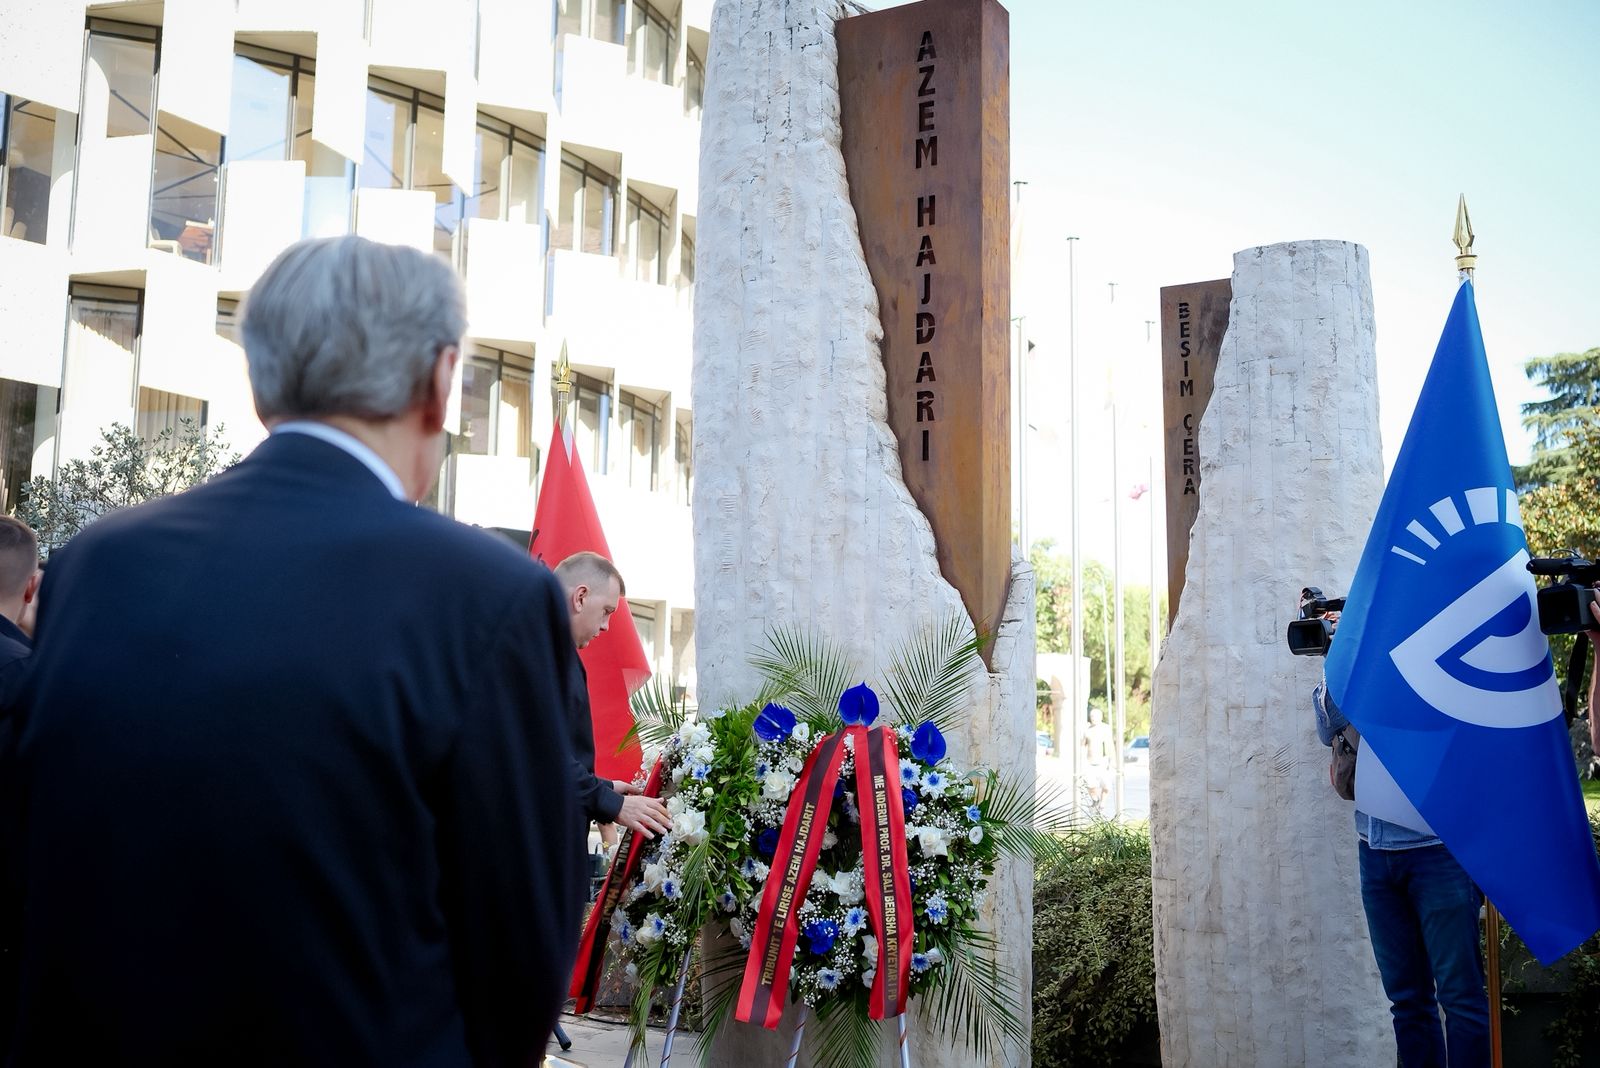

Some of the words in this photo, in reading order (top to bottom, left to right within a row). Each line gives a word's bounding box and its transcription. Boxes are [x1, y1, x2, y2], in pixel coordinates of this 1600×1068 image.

[915, 30, 938, 170] AZEM
[915, 194, 937, 462] HAJDARI
[1178, 302, 1194, 397] BESIM
[1183, 413, 1196, 495] ÇERA
[873, 774, 885, 789] ME
[876, 789, 889, 826] NDERIM
[794, 802, 816, 855] HAJDARIT
[879, 826, 890, 852] PROF.
[786, 855, 803, 884] AZEM
[881, 853, 891, 871] DR.
[776, 884, 794, 919] LIRISE
[882, 872, 893, 894] SALI
[883, 895, 896, 936] BERISHA
[761, 935, 782, 986] TRIBUNIT
[886, 937, 898, 979] KRYETAR
